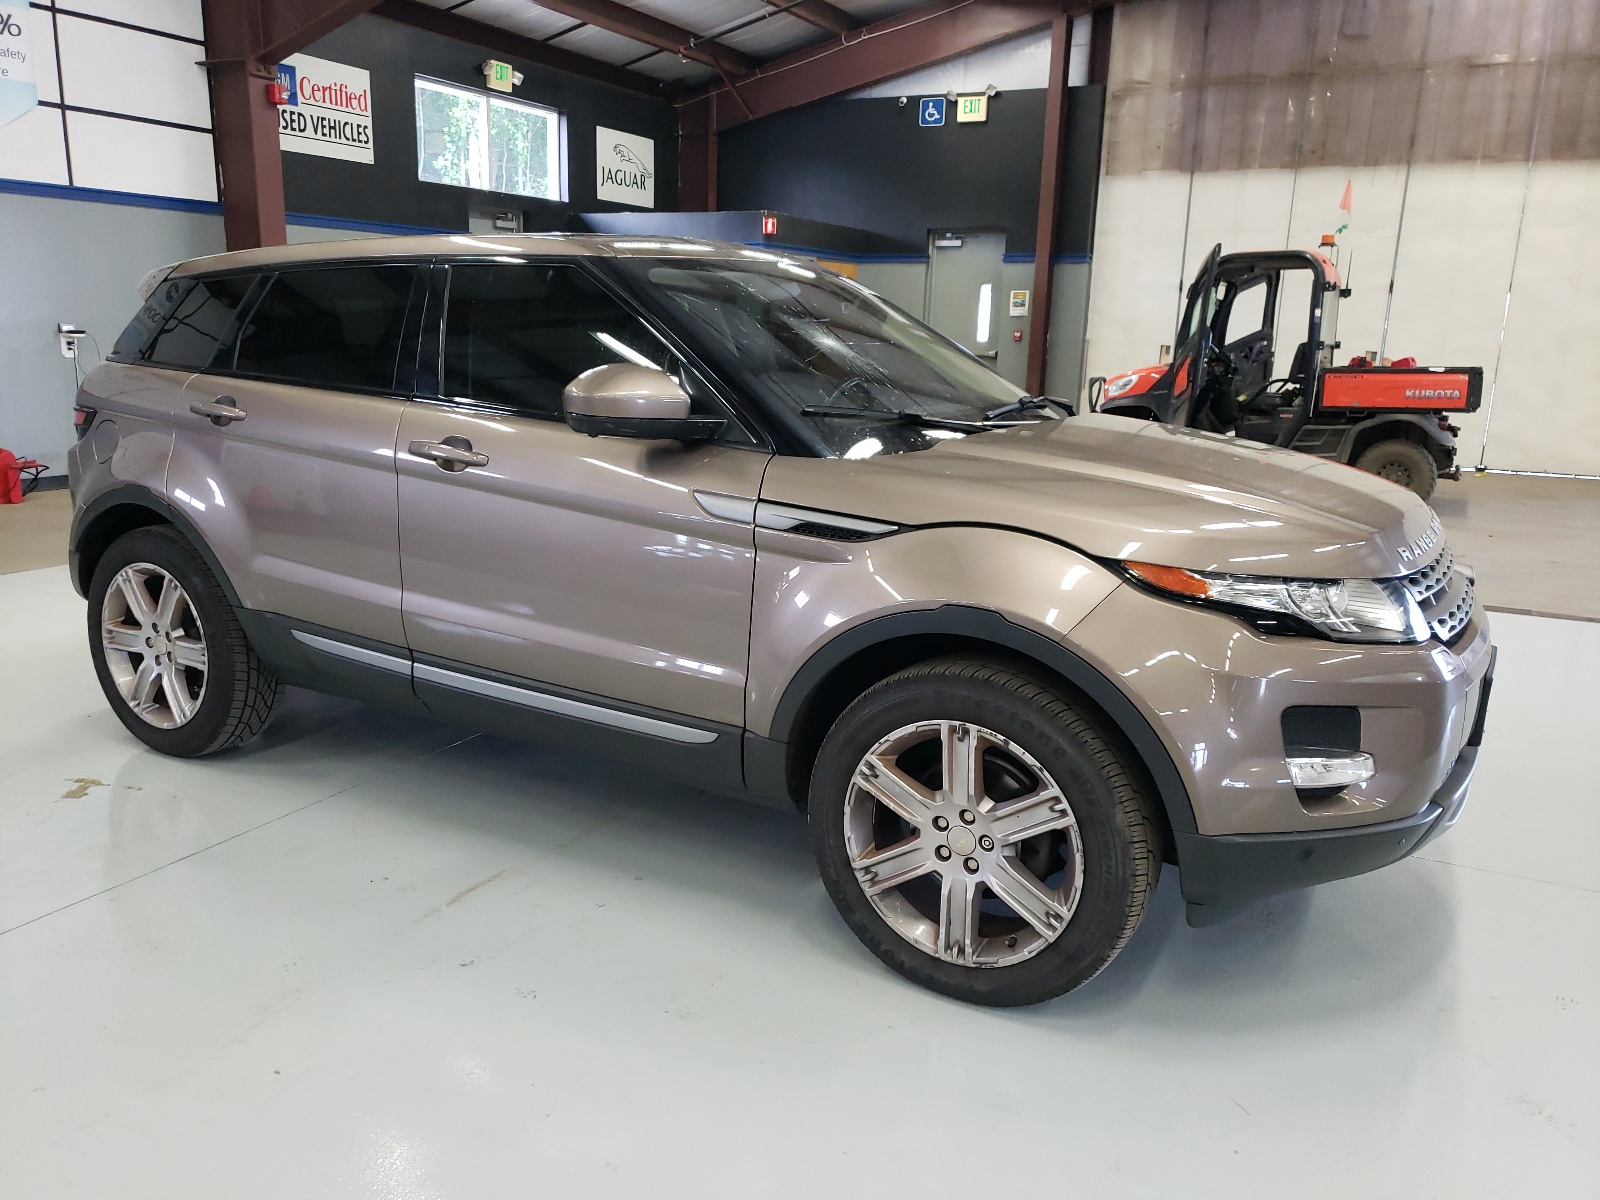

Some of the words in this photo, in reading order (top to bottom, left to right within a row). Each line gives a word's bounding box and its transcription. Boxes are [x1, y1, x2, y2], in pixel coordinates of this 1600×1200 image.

[0, 47, 27, 64] afety
[495, 63, 509, 82] EXIT
[299, 76, 368, 112] Certified
[963, 98, 983, 115] EXIT
[278, 107, 307, 133] SED
[310, 114, 370, 145] VEHICLES
[601, 165, 647, 191] JAGUAR
[1405, 389, 1462, 399] KUBOTA
